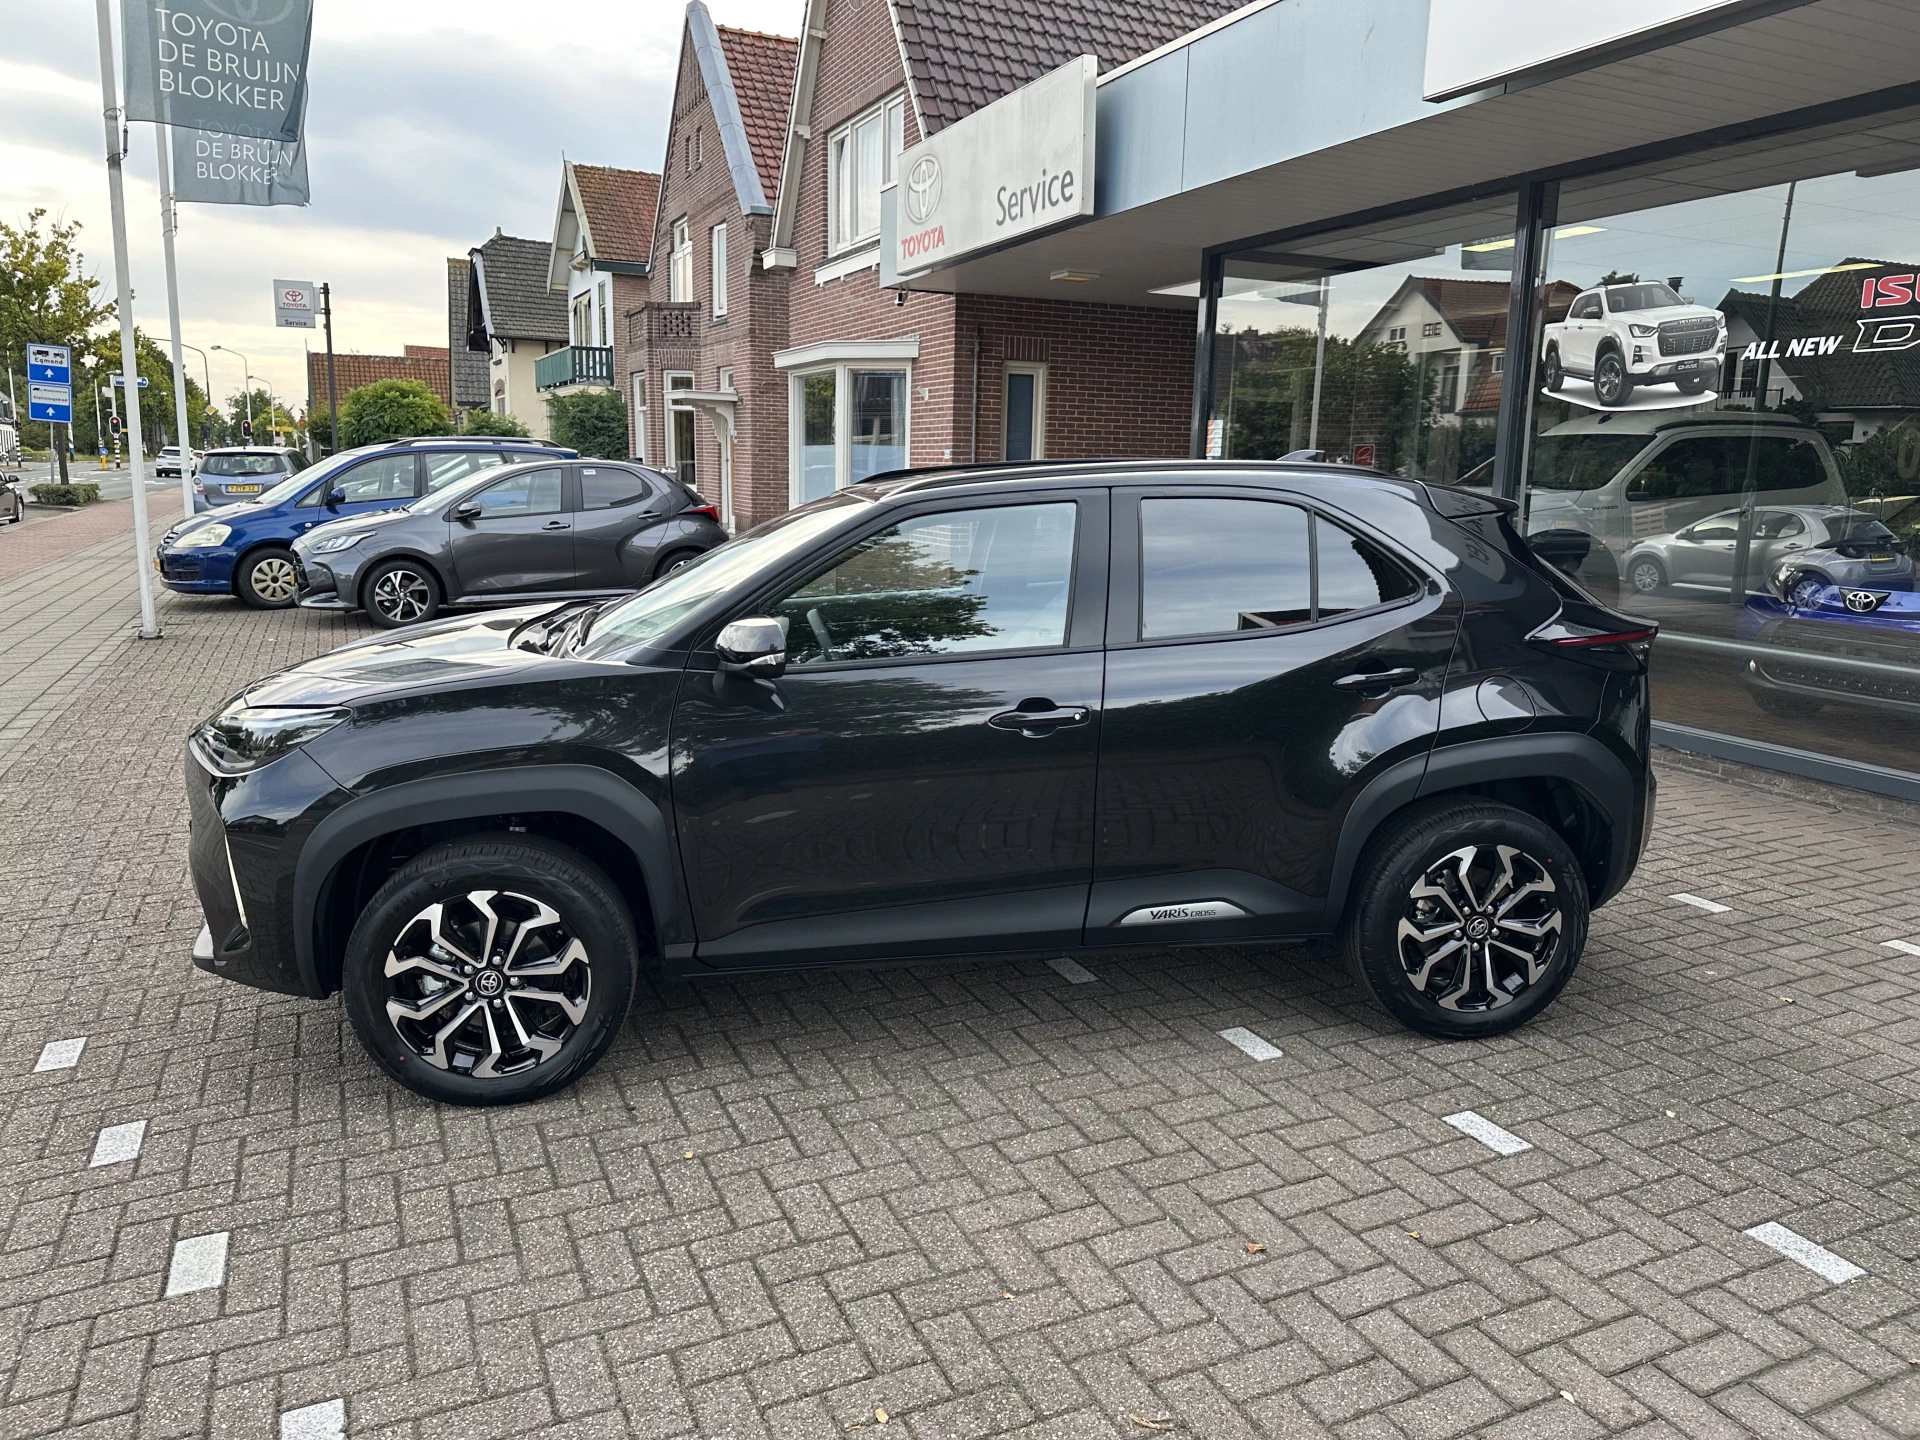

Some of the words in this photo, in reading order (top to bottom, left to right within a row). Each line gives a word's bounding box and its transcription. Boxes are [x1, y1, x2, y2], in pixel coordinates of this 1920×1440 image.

[155, 8, 270, 54] TOYOTA
[158, 39, 196, 68] DE
[207, 48, 299, 84] BRUIJN
[159, 68, 285, 111] BLOKKER
[196, 140, 223, 159] DE
[197, 161, 280, 185] BLOKKER
[996, 168, 1074, 227] Service
[901, 225, 946, 260] TOYOTA
[1861, 273, 1920, 309] IS
[34, 357, 63, 365] Egmond
[1740, 340, 1781, 361] ALL
[1785, 335, 1844, 358] NEW
[1190, 909, 1216, 918] CROSS
